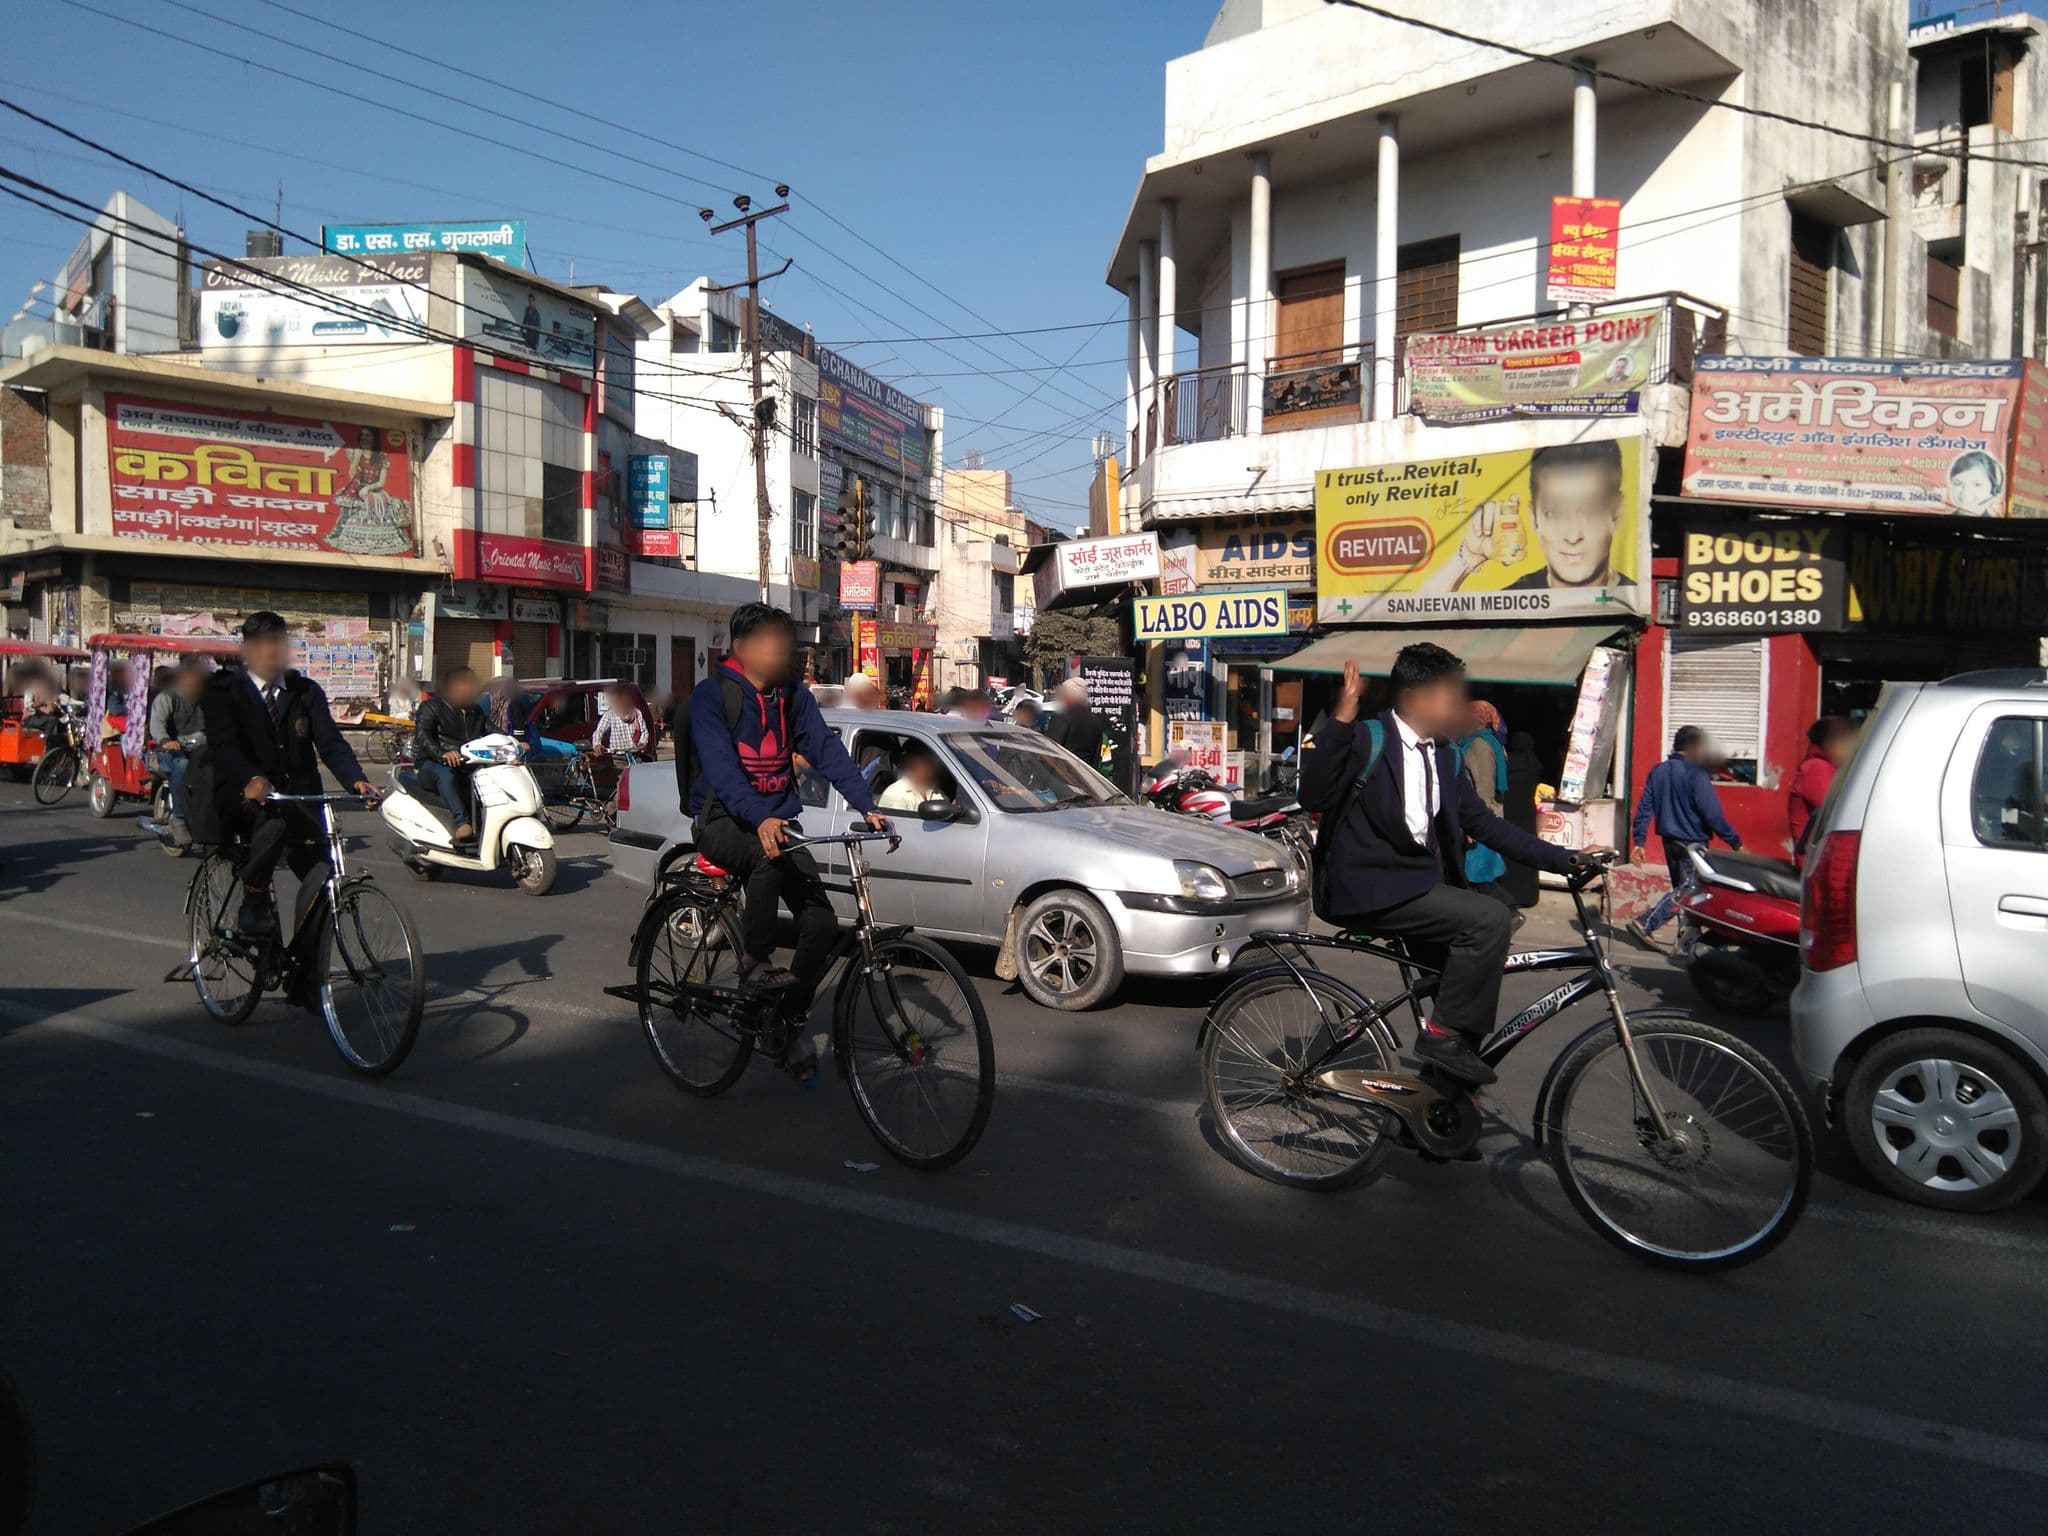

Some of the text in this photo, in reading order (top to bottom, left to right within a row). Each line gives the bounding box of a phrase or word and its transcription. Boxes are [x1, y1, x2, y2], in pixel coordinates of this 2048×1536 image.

[336, 234, 360, 250] डा.
[365, 233, 398, 249] एस.
[403, 232, 436, 248] एस.
[207, 259, 424, 287] Oriental Music Palace
[1494, 325, 1576, 352] CAREER
[1586, 315, 1655, 343] POINT
[1505, 358, 1531, 369] Special
[1533, 356, 1555, 366] Batch
[1700, 358, 2011, 377] अंग्रेजी बोलना सीखिए
[821, 380, 841, 408] SSC
[829, 354, 882, 401] CHANAKYA
[885, 389, 924, 424] ACADEMY
[1703, 379, 2008, 432] अमेरिकन
[112, 444, 338, 496] कविता
[1839, 454, 1901, 468] Presentation
[1911, 457, 1948, 469] Debate
[1325, 473, 1332, 488] I
[113, 484, 329, 513] साड़ी सदन
[1345, 481, 1459, 506] only Revital
[114, 509, 173, 528] साड़ी
[181, 514, 254, 531] लहंगा
[1101, 547, 1122, 564] जूस
[1123, 539, 1152, 557] कार्नर
[1221, 529, 1316, 562] AIDS
[1338, 537, 1421, 559] REVITAL
[1688, 528, 1830, 565] BOOBY
[491, 548, 526, 568] Oriental
[528, 552, 551, 571] Music
[1246, 563, 1292, 578] साइंस
[1686, 568, 1823, 604] SHOES
[1141, 600, 1206, 634] LABO
[1216, 597, 1280, 629] AIDS
[1387, 594, 1550, 613] SANJEEVANI MEDICOS
[1688, 609, 1821, 626] 9368601380
